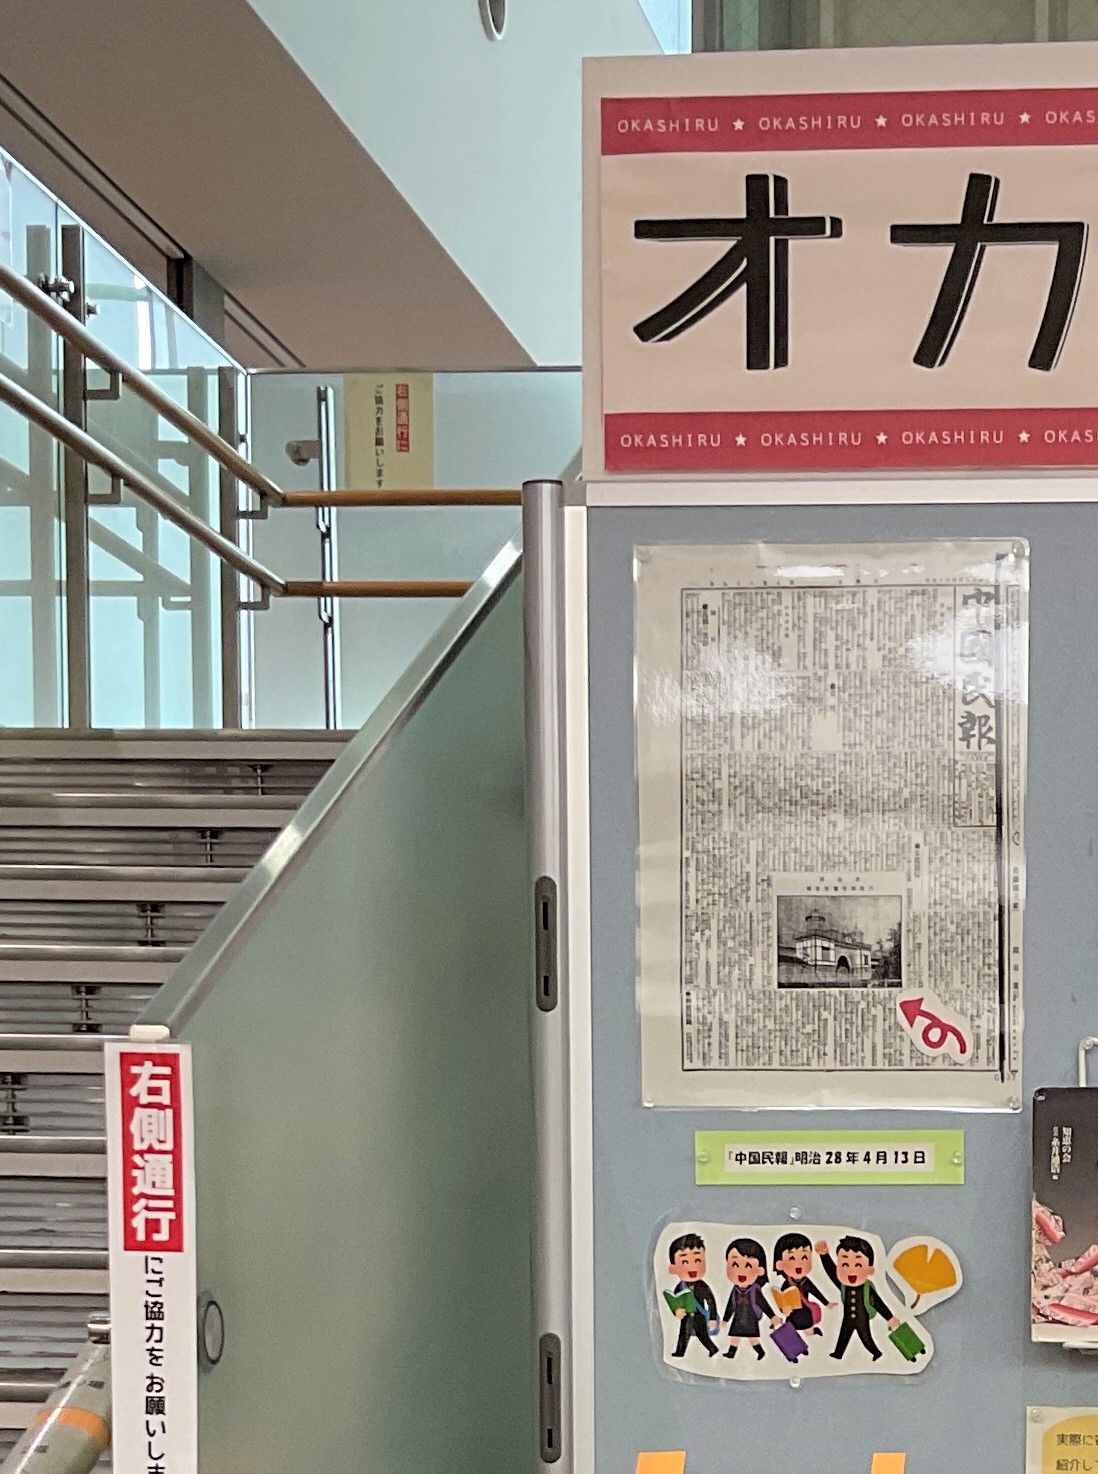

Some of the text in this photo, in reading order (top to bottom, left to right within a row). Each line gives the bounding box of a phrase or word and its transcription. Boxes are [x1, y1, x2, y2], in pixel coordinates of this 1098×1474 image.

[617, 117, 719, 133] OKASHIRU
[759, 115, 861, 131] OKASHIRU
[902, 111, 1004, 128] OKASHIRU
[620, 432, 721, 448] OKASHIRU
[761, 431, 862, 447] OKASHIRU
[902, 430, 1004, 445] OKASHIRU
[129, 1060, 175, 1242] 右側通行
